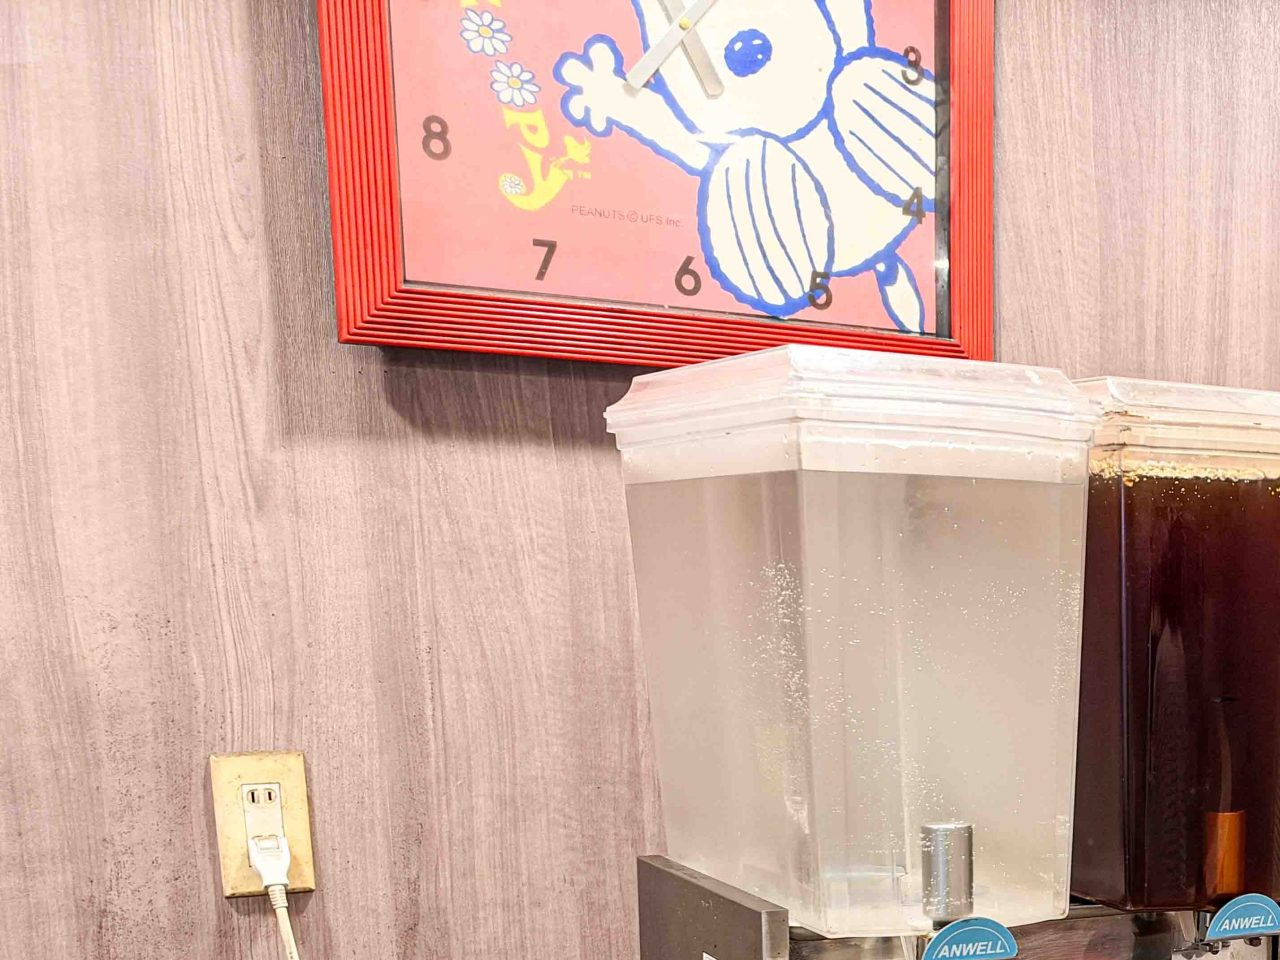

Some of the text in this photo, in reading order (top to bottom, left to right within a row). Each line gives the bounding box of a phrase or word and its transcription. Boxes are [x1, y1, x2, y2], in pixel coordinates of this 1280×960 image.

[421, 115, 452, 161] 8
[571, 204, 626, 221] PEANUTS
[902, 186, 926, 225] 4
[532, 239, 558, 282] 7
[674, 256, 702, 297] 6
[808, 271, 832, 311] 5
[1221, 914, 1276, 931] ANWELL
[937, 940, 1006, 959] ANWELL
